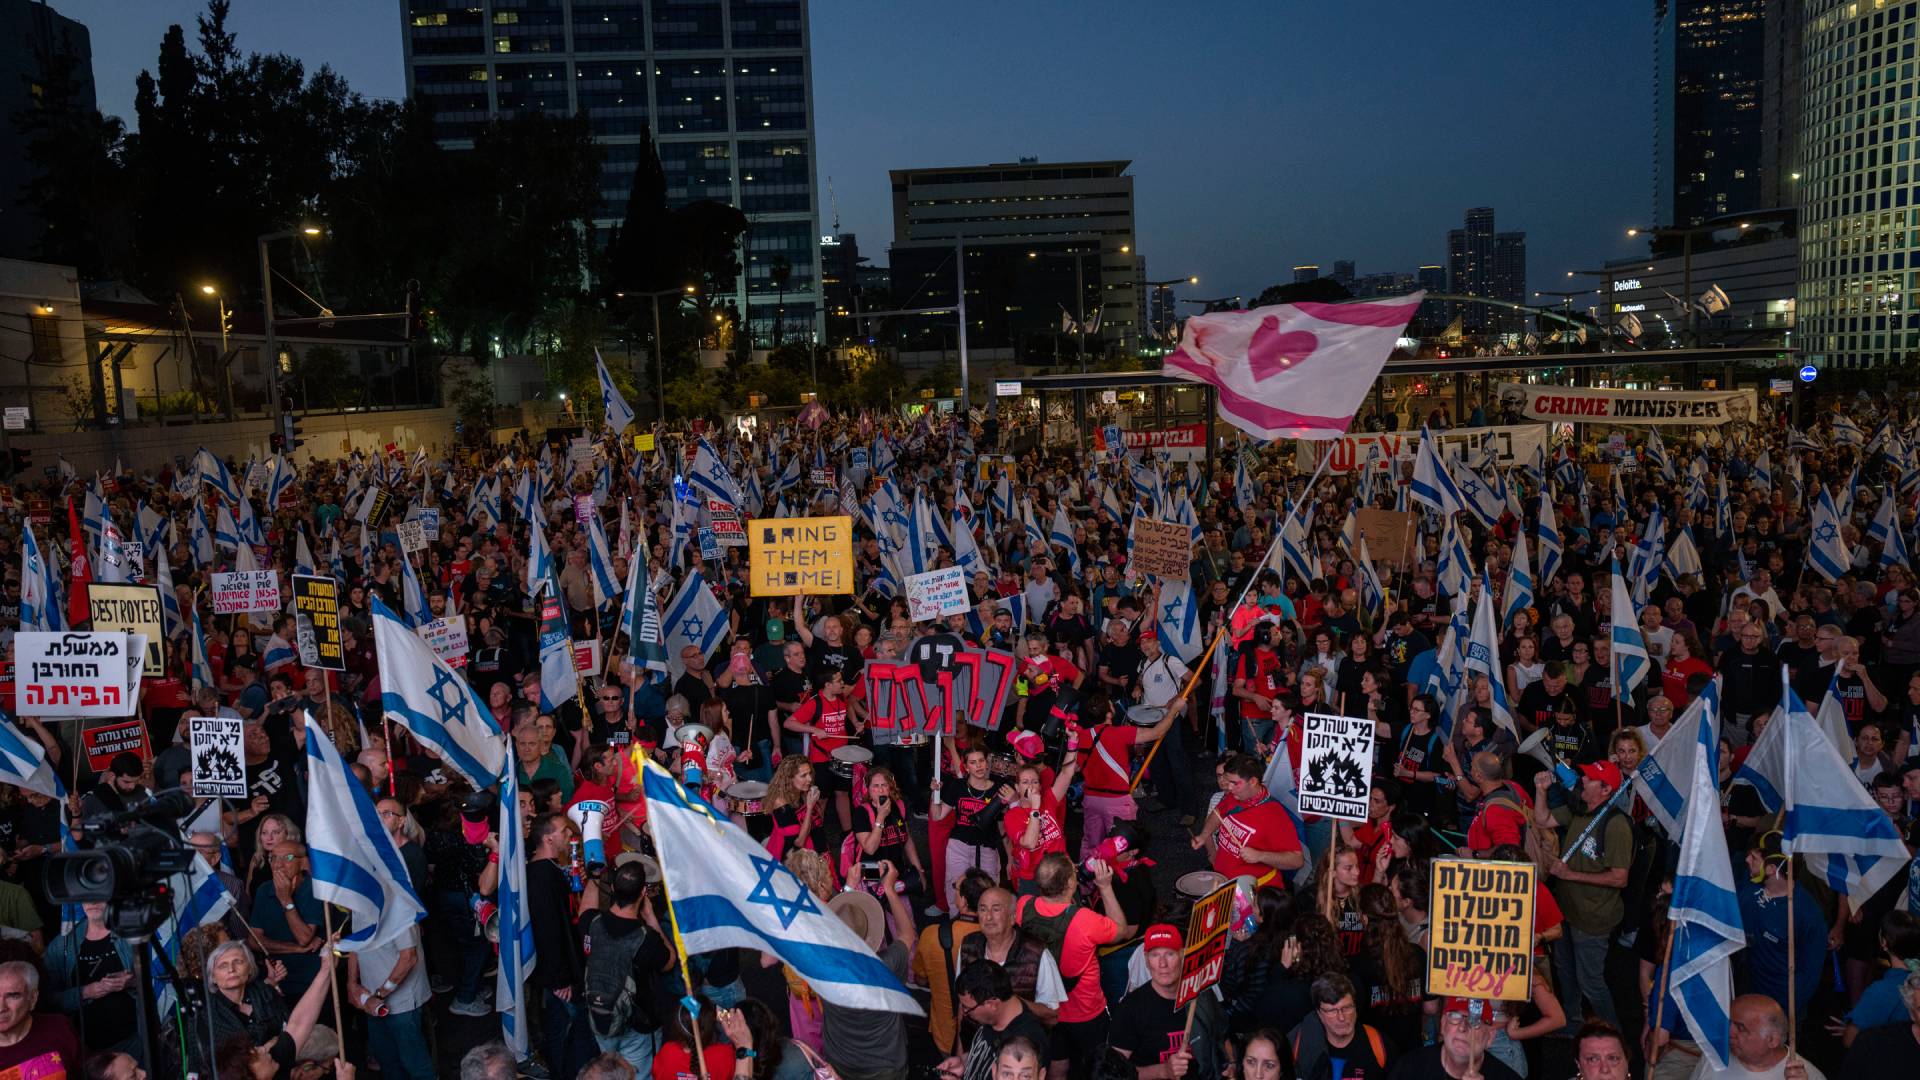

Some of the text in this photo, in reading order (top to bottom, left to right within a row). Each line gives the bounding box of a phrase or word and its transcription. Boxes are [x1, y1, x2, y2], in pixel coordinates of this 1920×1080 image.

[1535, 396, 1721, 418] CRIME MINISTER
[763, 549, 828, 566] THEM
[766, 569, 841, 590] HOME!
[91, 599, 160, 624] DESTROYER
[45, 633, 119, 657] ממשלת
[327, 628, 340, 643] את
[26, 684, 121, 707] הביתה
[192, 720, 241, 733] מי שהרס
[1307, 716, 1373, 738] מי שהרס
[194, 733, 241, 746] לא יתקן
[1307, 732, 1371, 753] לא יתקן
[1302, 795, 1366, 817] בחירות עכשיו!
[1438, 864, 1529, 895] ממשלת
[1443, 892, 1523, 921] כישלון
[1443, 919, 1520, 948] מוחלט
[1433, 946, 1527, 976] מחליפים
[1446, 961, 1517, 997] עכשיו!
